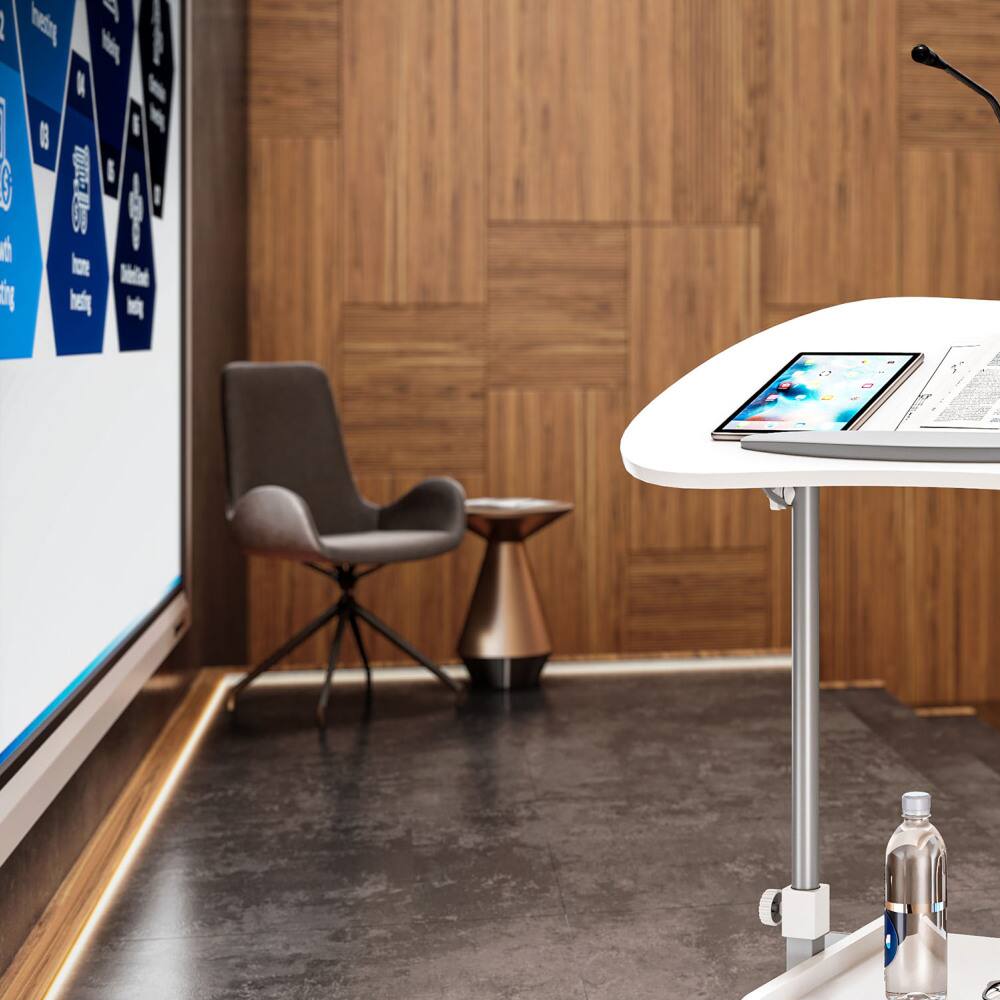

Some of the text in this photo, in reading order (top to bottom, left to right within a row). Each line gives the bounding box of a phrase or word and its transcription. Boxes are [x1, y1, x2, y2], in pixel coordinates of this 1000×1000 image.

[31, 1, 58, 48] Investing
[39, 120, 50, 151] 03
[0, 235, 13, 264] wth
[71, 252, 91, 277] Income
[69, 288, 93, 317] Investing
